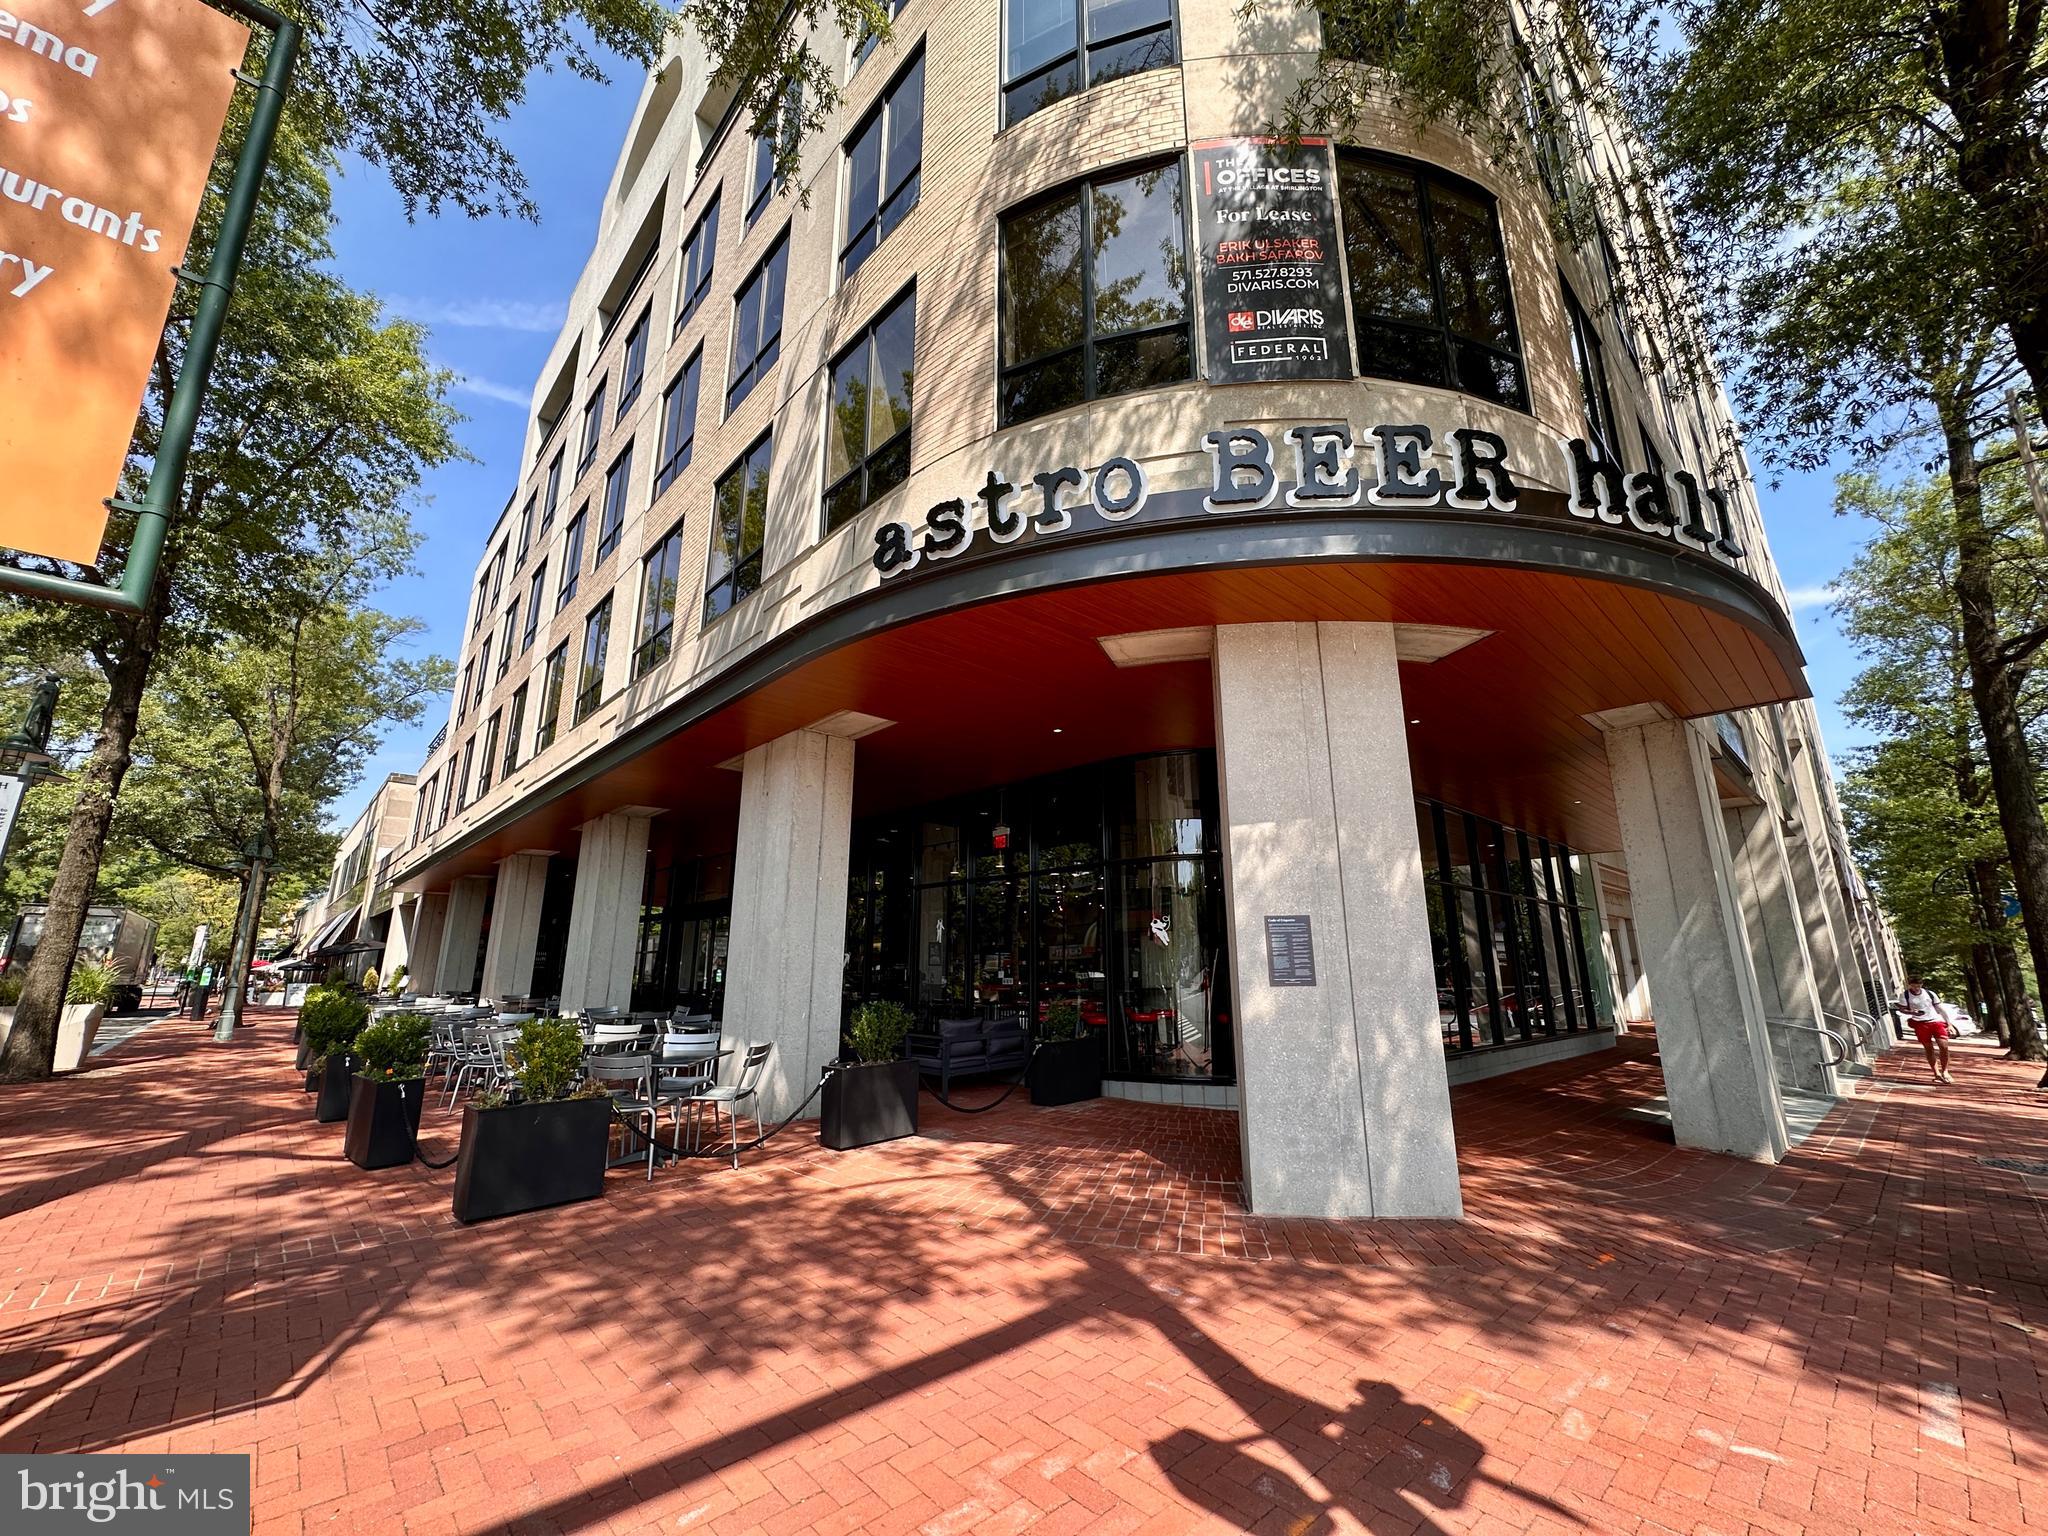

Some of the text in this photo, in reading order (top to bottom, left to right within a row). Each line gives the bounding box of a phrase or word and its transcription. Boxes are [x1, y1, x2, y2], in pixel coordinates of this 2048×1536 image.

[1216, 159, 1243, 168] THE
[1216, 167, 1321, 185] OFFICES
[1216, 209, 1250, 224] For
[1219, 238, 1320, 254] ERIK ULSAKER
[1216, 249, 1325, 264] BAKH SAFAROV
[1232, 267, 1313, 281] 571.527.8293
[1227, 279, 1320, 293] DIVARIS.COM
[1256, 308, 1325, 326] DIVARIS
[1237, 343, 1321, 357] FEDERAL
[873, 424, 1744, 579] astro BEER hall
